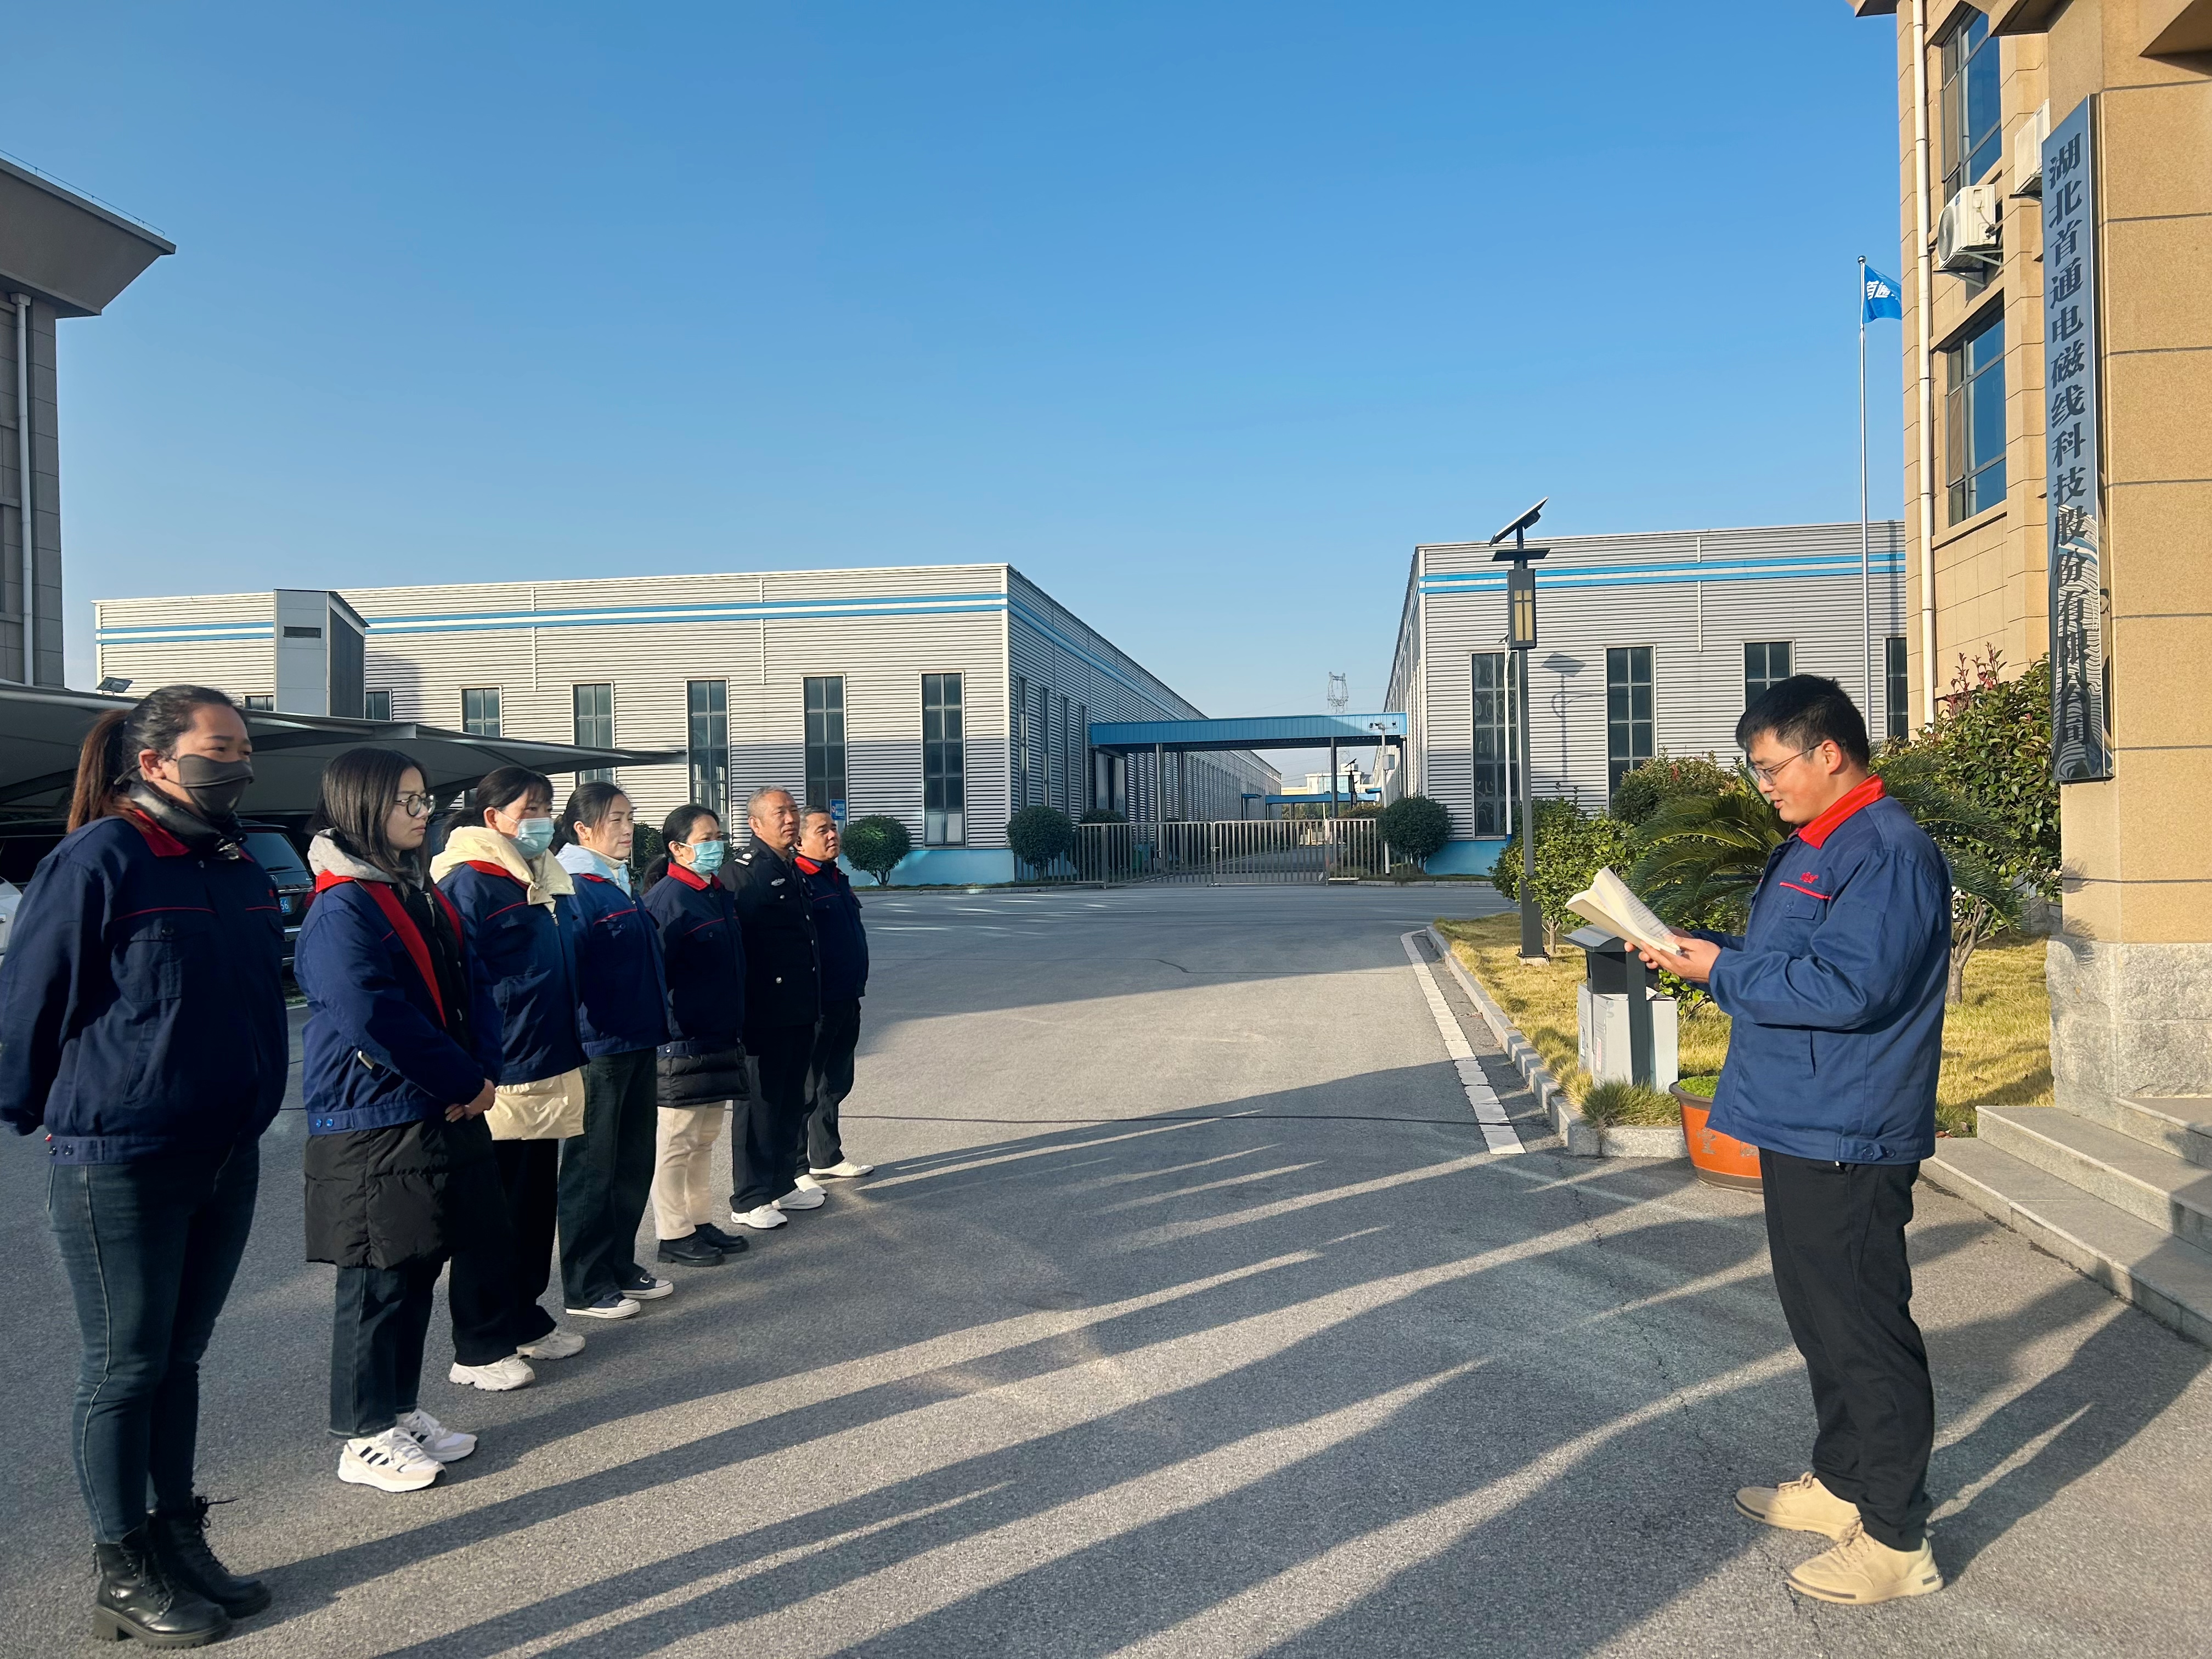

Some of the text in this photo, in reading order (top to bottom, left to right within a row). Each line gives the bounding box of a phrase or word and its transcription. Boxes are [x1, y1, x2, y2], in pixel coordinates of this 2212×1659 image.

[2049, 132, 2091, 746] 湖北首通电磁线科技股份有限公司
